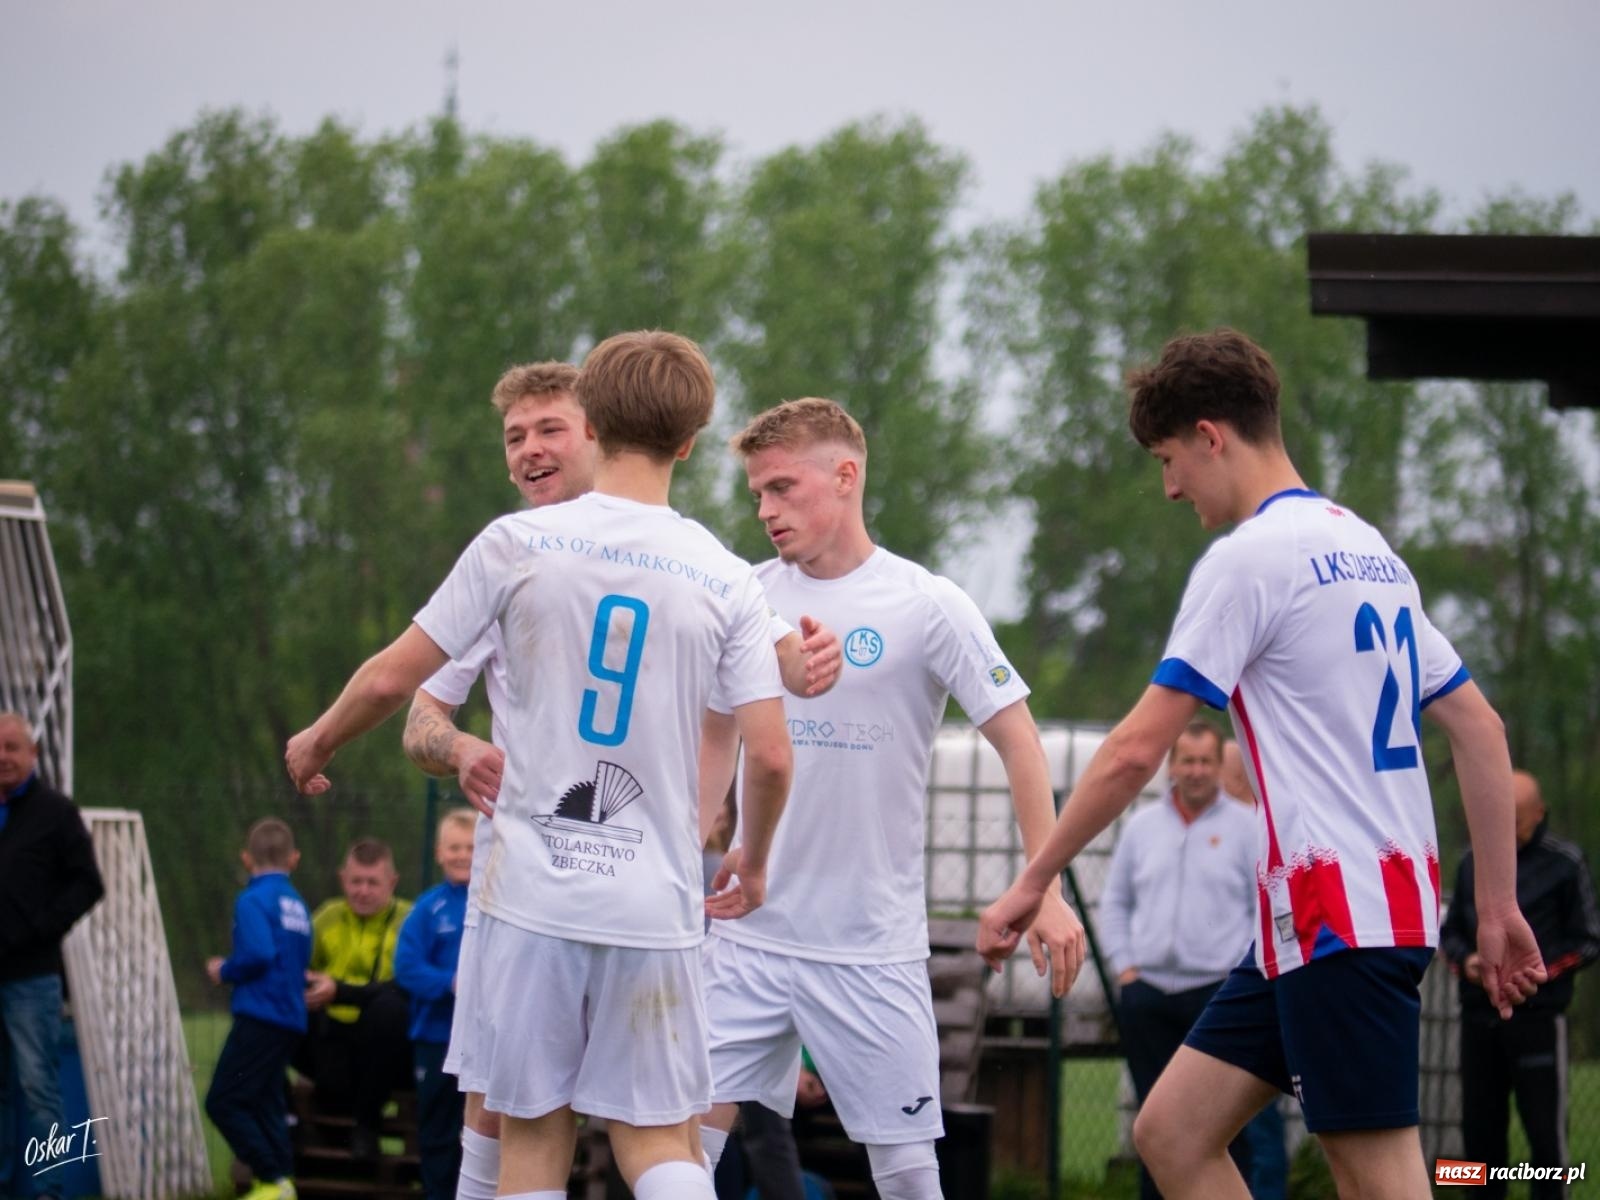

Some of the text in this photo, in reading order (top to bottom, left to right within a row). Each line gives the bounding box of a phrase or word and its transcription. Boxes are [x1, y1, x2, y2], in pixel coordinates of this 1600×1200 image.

[528, 535, 732, 600] LKS 07 MARKOWICE
[1310, 551, 1355, 585] LKS
[850, 631, 878, 654] LKS
[578, 594, 650, 747] 9
[1354, 602, 1420, 772] 21
[843, 722, 894, 742] TECH
[551, 854, 616, 877] ZBECZKA
